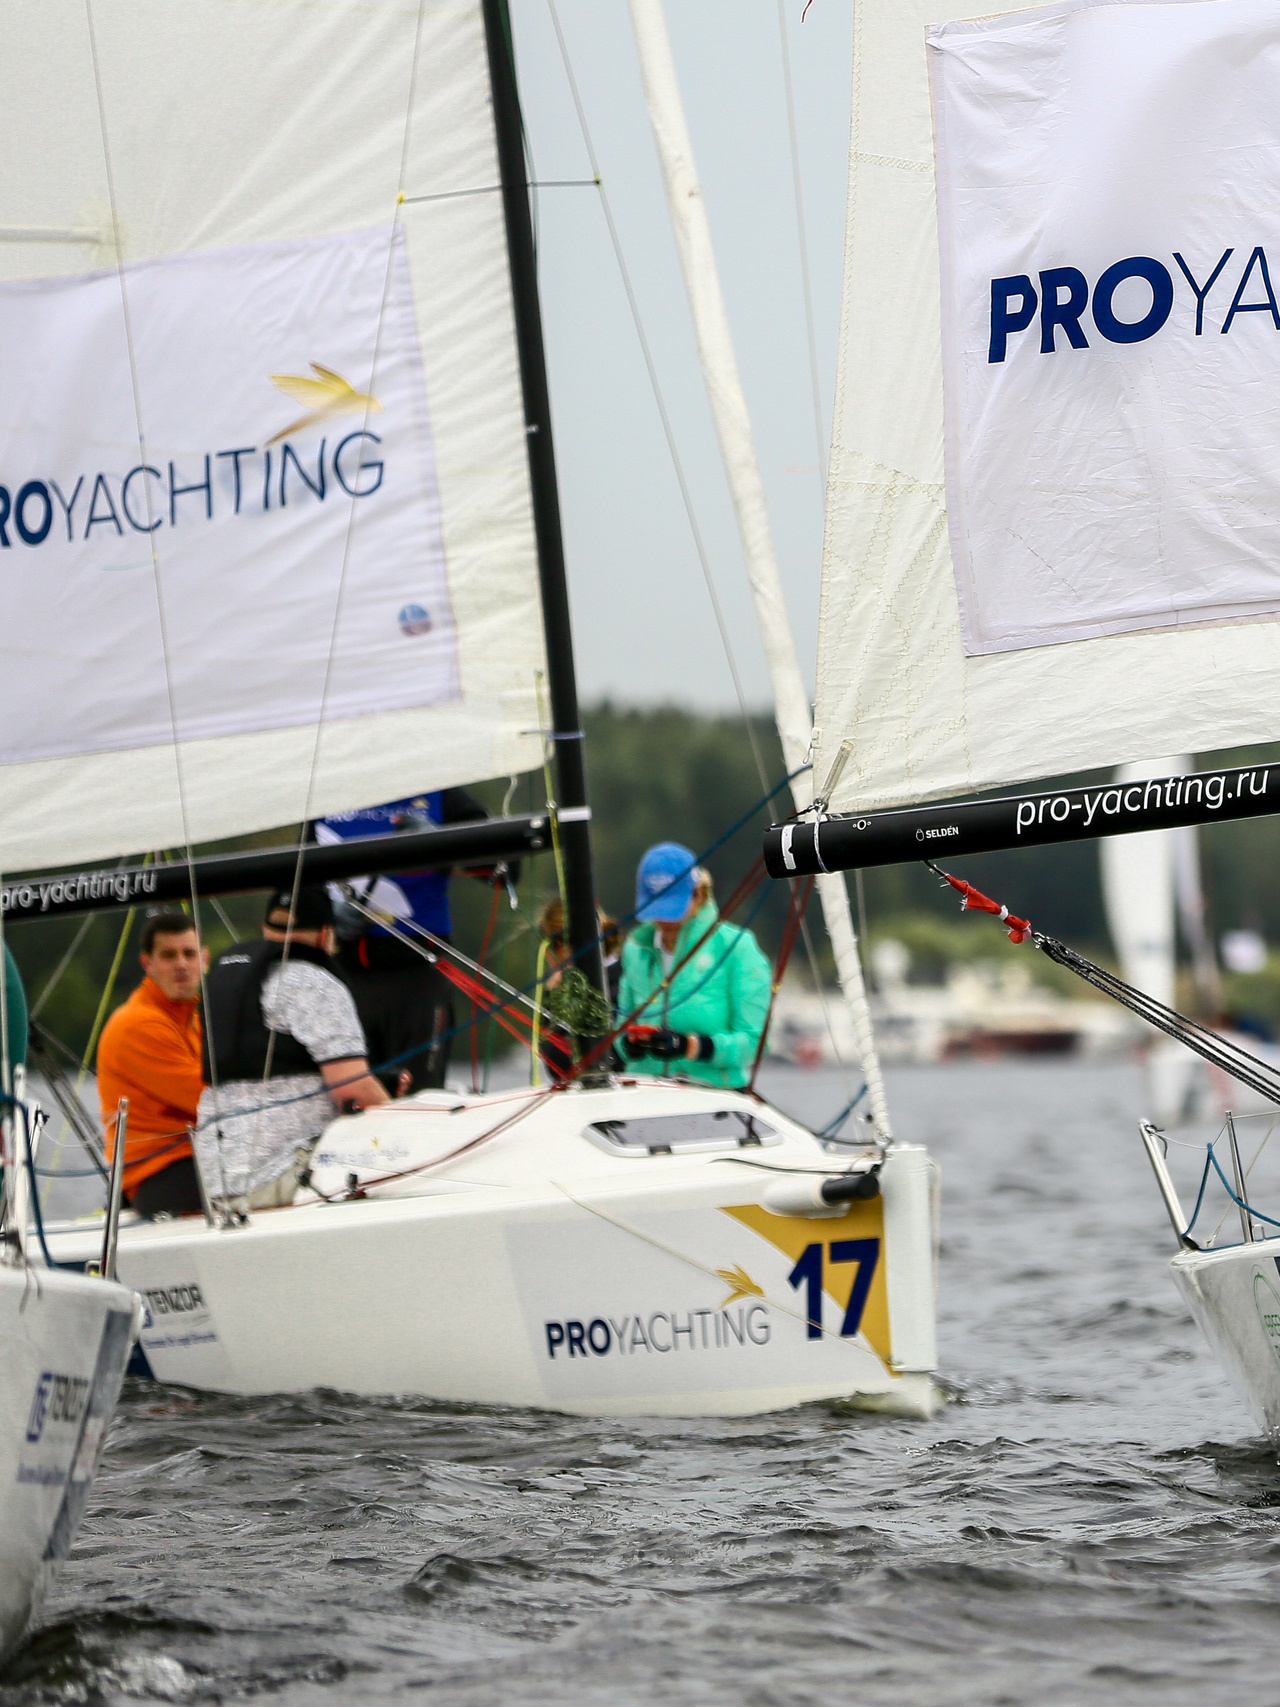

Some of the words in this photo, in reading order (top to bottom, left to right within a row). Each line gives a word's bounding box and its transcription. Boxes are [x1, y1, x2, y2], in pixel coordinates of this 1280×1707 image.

[1015, 769, 1270, 834] pro-yachting.ru
[925, 825, 959, 839] SELDÉN
[786, 1237, 880, 1342] 17
[544, 1305, 772, 1360] PROYACHTING
